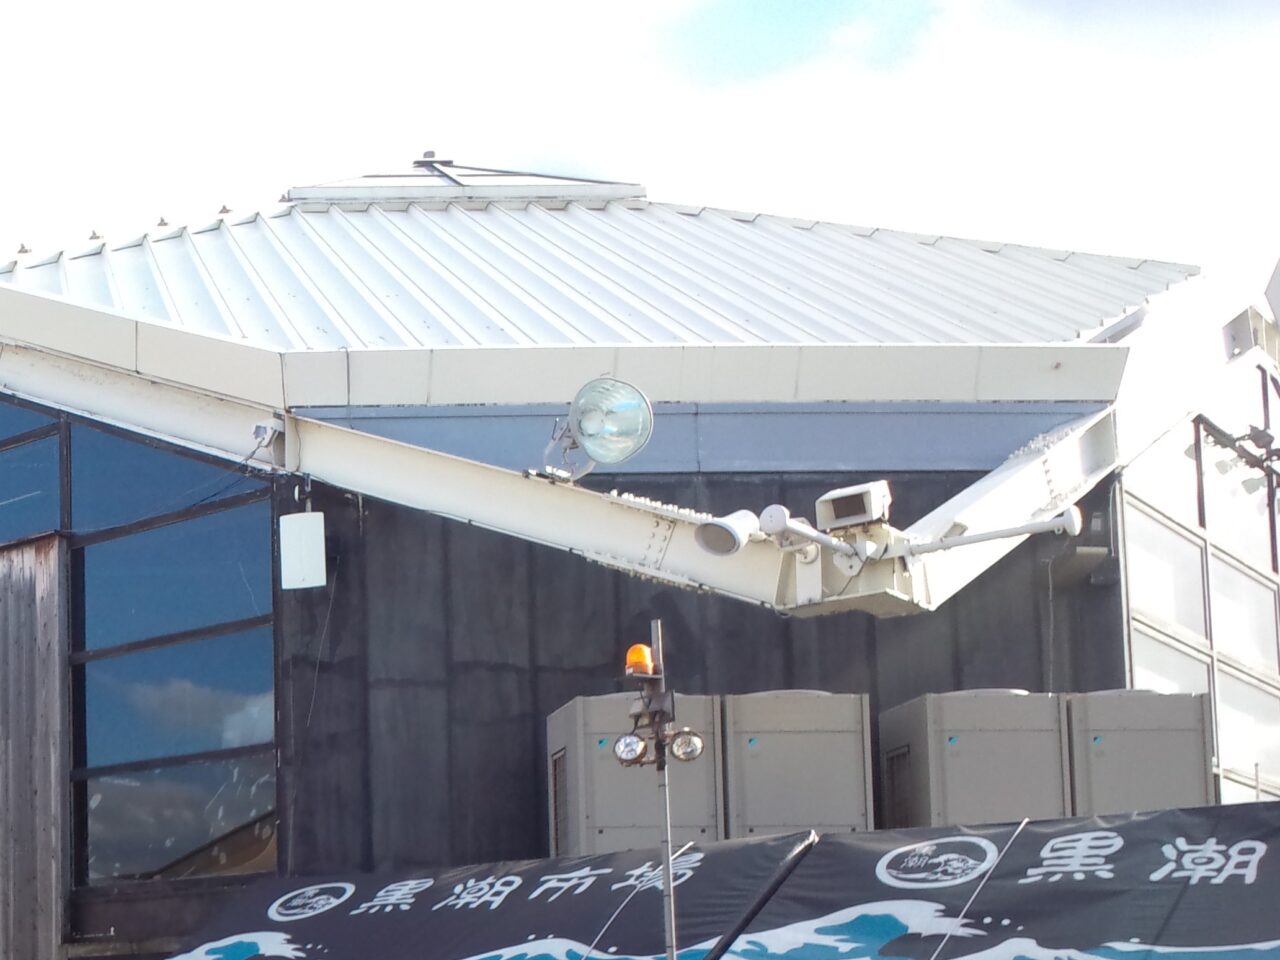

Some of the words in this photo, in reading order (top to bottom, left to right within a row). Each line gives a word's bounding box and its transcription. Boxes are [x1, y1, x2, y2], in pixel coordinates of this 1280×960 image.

[349, 852, 705, 915] 黒潮市場
[1018, 831, 1267, 885] 黒潮
